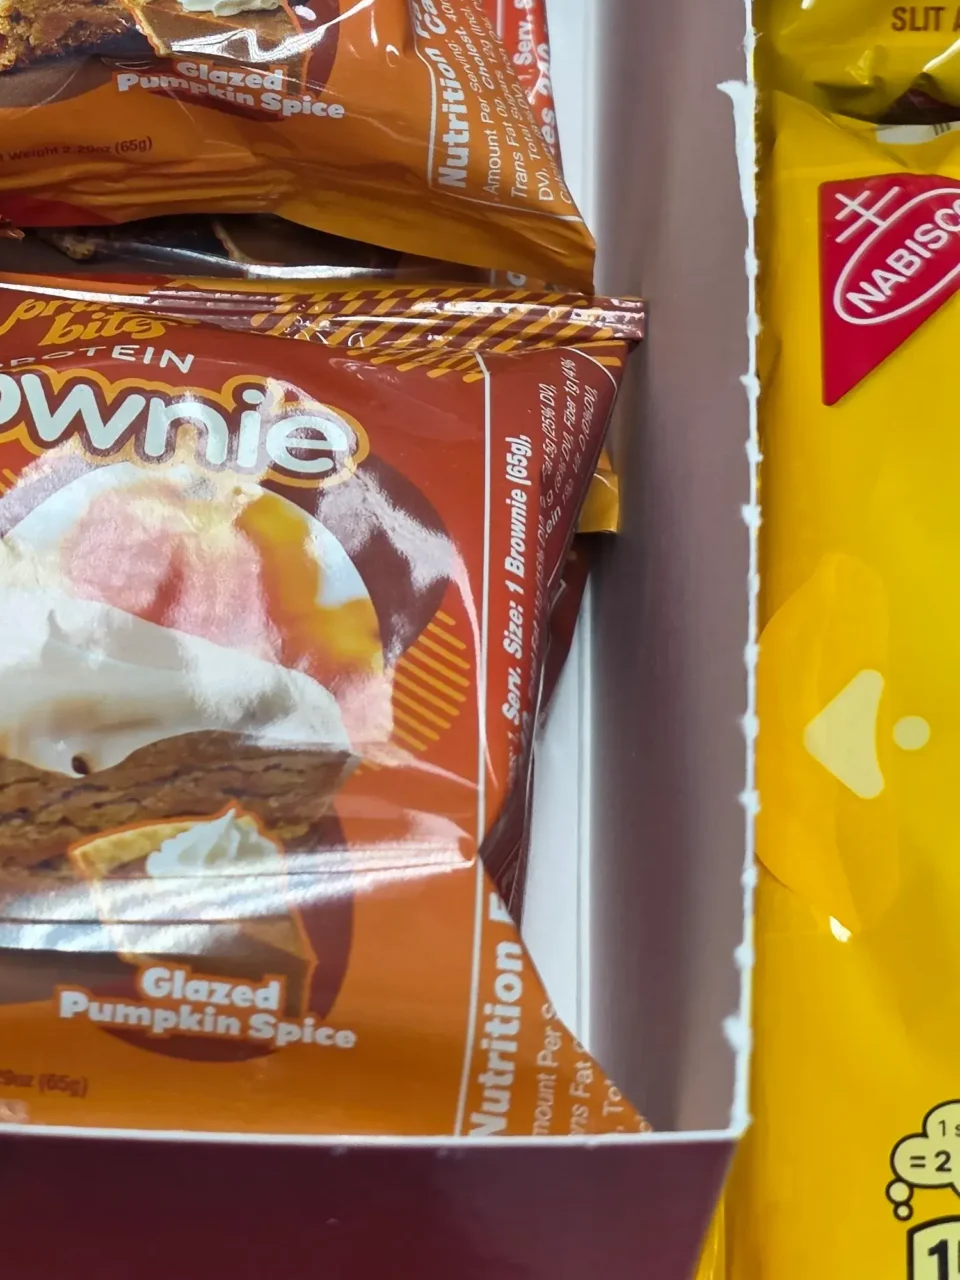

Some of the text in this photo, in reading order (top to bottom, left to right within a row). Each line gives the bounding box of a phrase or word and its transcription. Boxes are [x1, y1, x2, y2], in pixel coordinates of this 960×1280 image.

[514, 15, 532, 64] Serv.
[891, 6, 946, 32] SLIT
[176, 61, 284, 93] Glazed
[444, 39, 482, 91] Serving:
[454, 28, 495, 88] Cholest.
[117, 73, 345, 119] Pumpkin Spice
[478, 97, 494, 122] Per
[494, 70, 522, 118] Sugars
[425, 46, 465, 188] Nutrition
[504, 122, 519, 144] Fat
[114, 136, 153, 157] (65g)
[482, 129, 498, 192] Amount
[517, 125, 540, 160] Total
[511, 152, 526, 197] Trans
[535, 168, 554, 199] DV),
[560, 356, 579, 381] (4%
[566, 380, 578, 394] 1g
[538, 382, 557, 455] 5g (25% DV),
[564, 397, 576, 430] Fiber
[504, 434, 532, 485] (65g),
[503, 487, 528, 578] Brownie
[505, 579, 524, 594] 1
[502, 599, 523, 658] Size:
[501, 666, 521, 724] Serv.
[142, 967, 281, 1011] Glazed
[59, 990, 357, 1049] Pumpkin Spice
[467, 941, 522, 1135] Nutrition
[535, 1024, 563, 1067] Per
[39, 1075, 89, 1099] (65g)
[567, 1059, 591, 1097] Fat
[530, 1072, 556, 1134] mount
[939, 1119, 947, 1138] 1
[934, 1149, 953, 1173] 2
